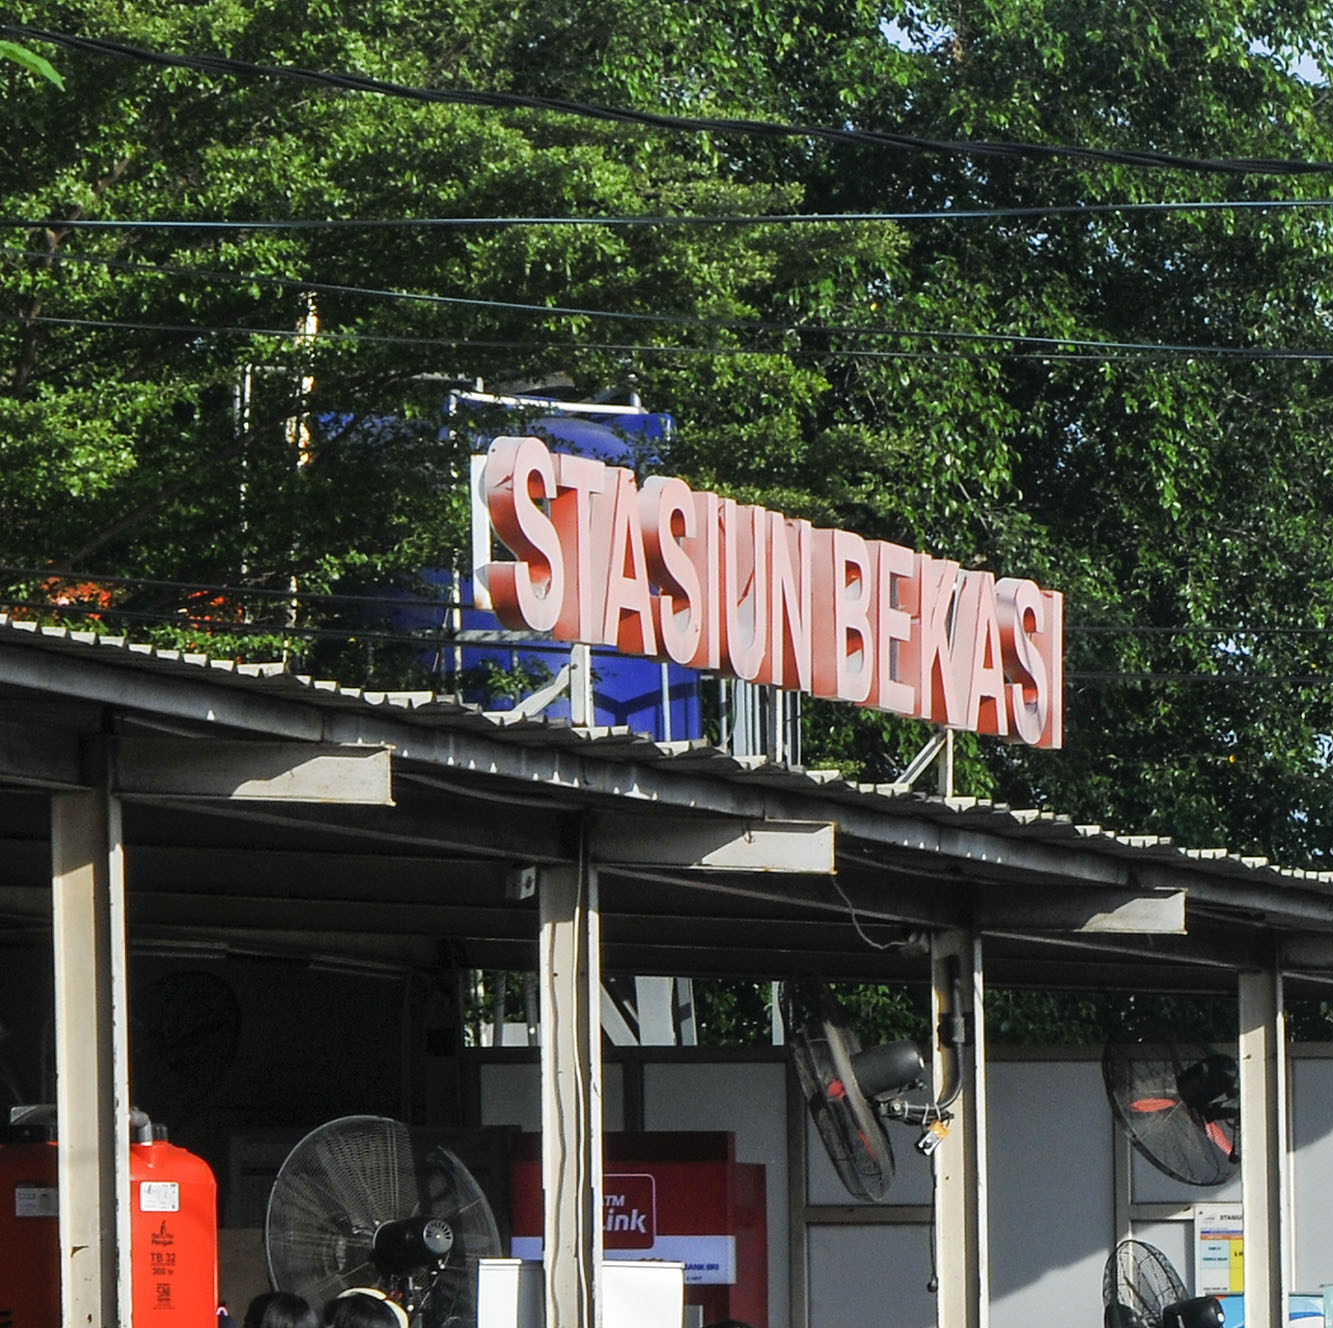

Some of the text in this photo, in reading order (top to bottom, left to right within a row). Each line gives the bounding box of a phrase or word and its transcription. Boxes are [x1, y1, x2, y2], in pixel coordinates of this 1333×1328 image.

[485, 436, 1063, 749] STASIUN BEKASI
[603, 1195, 625, 1206] TM
[603, 1208, 647, 1233] ink
